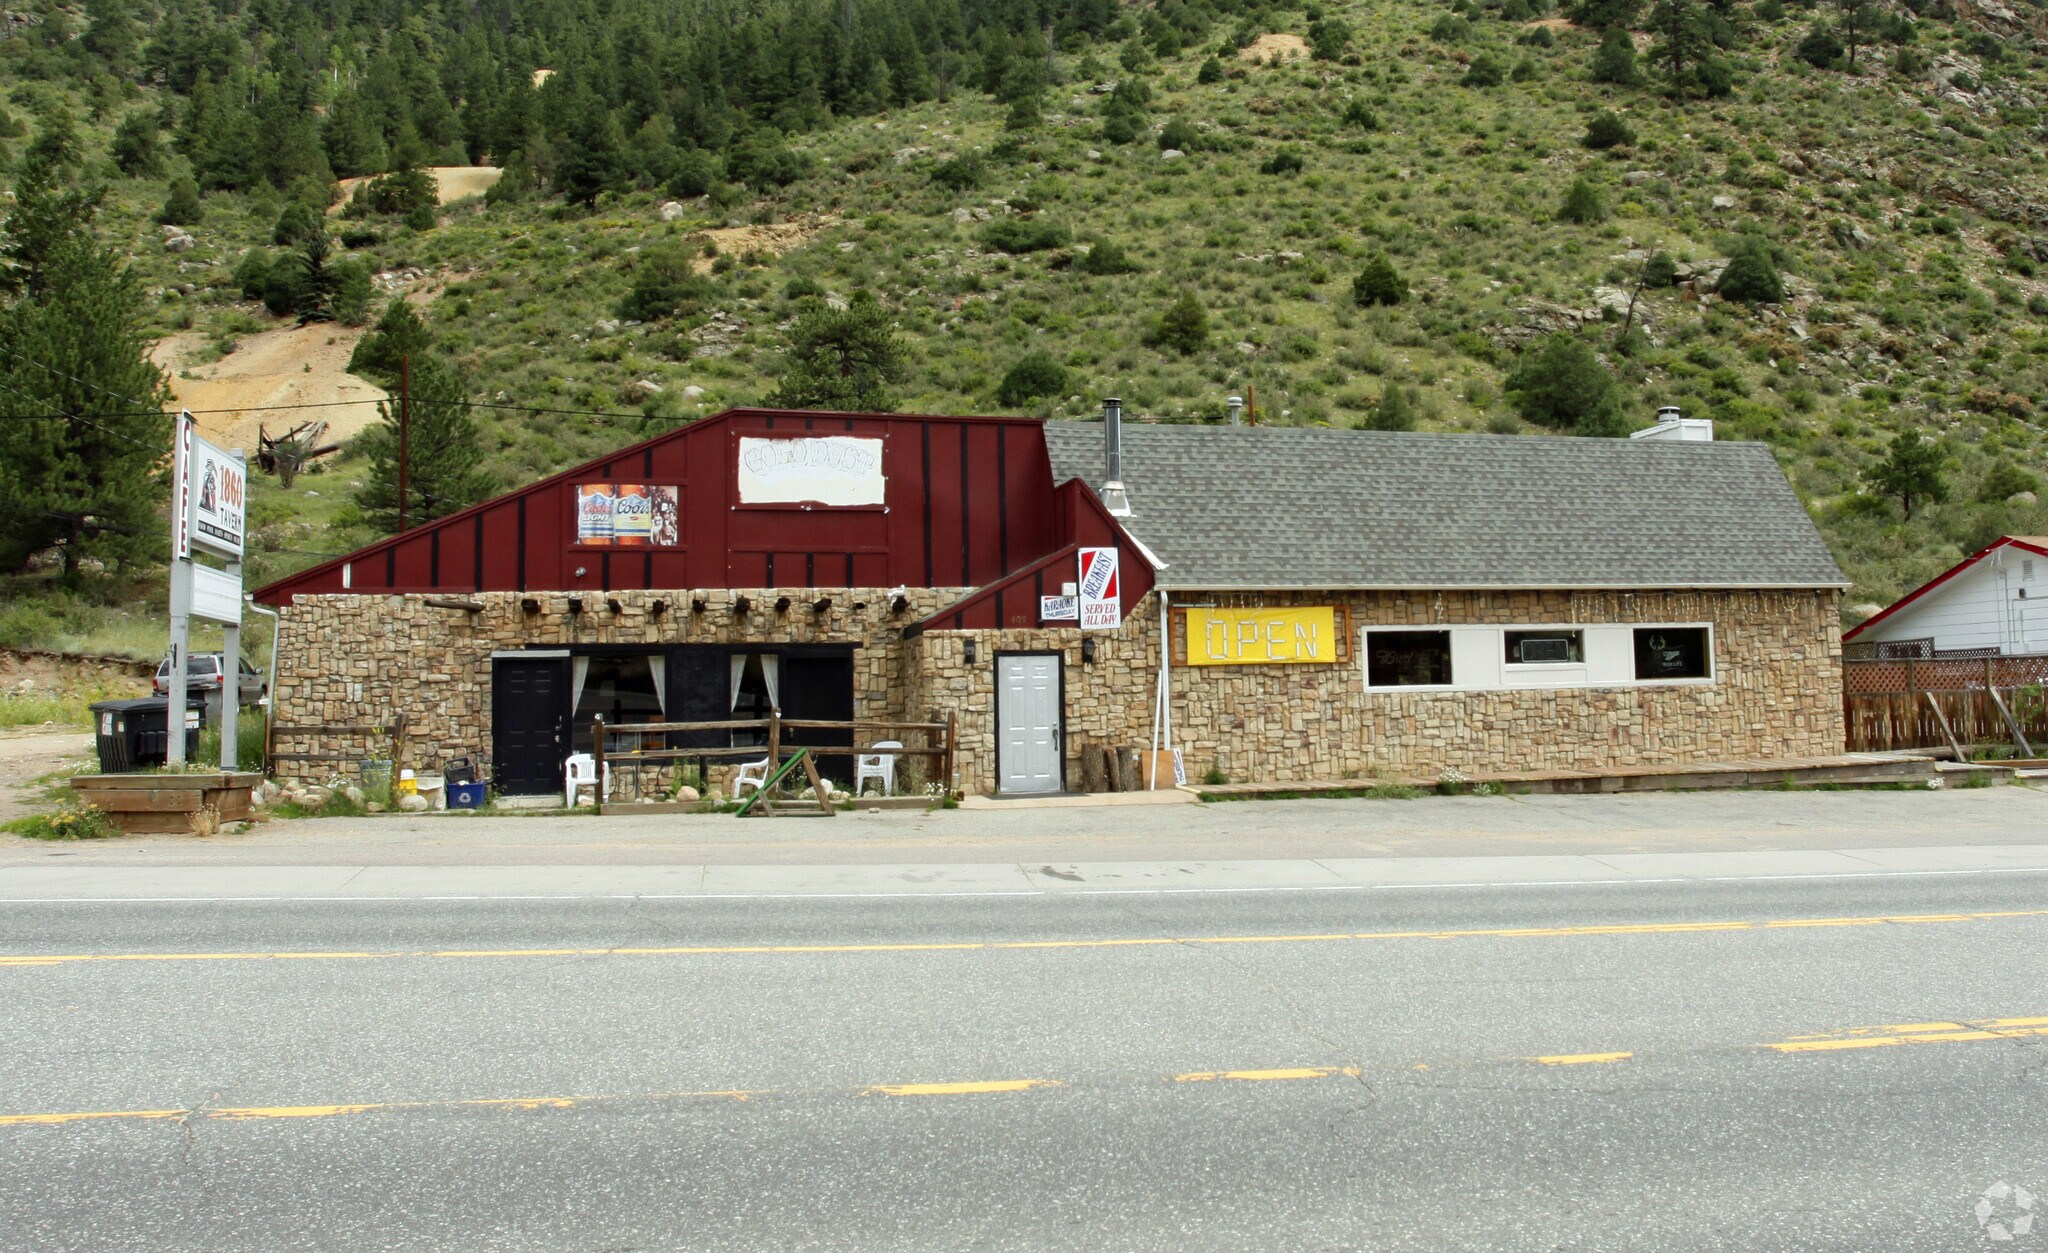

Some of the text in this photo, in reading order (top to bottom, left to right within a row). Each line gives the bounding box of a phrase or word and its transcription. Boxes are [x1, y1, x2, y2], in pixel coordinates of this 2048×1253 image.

[181, 420, 190, 553] CAFE
[219, 464, 243, 510] 1860
[617, 498, 650, 515] Coors
[220, 507, 242, 532] TAVERN
[1083, 551, 1113, 600] BREAKFAST
[1044, 597, 1075, 612] KARAOKE
[1045, 608, 1075, 619] THURSDAY
[1084, 603, 1116, 615] SERVED
[1084, 614, 1117, 626] ALL DAY
[1206, 619, 1317, 660] OPEN
